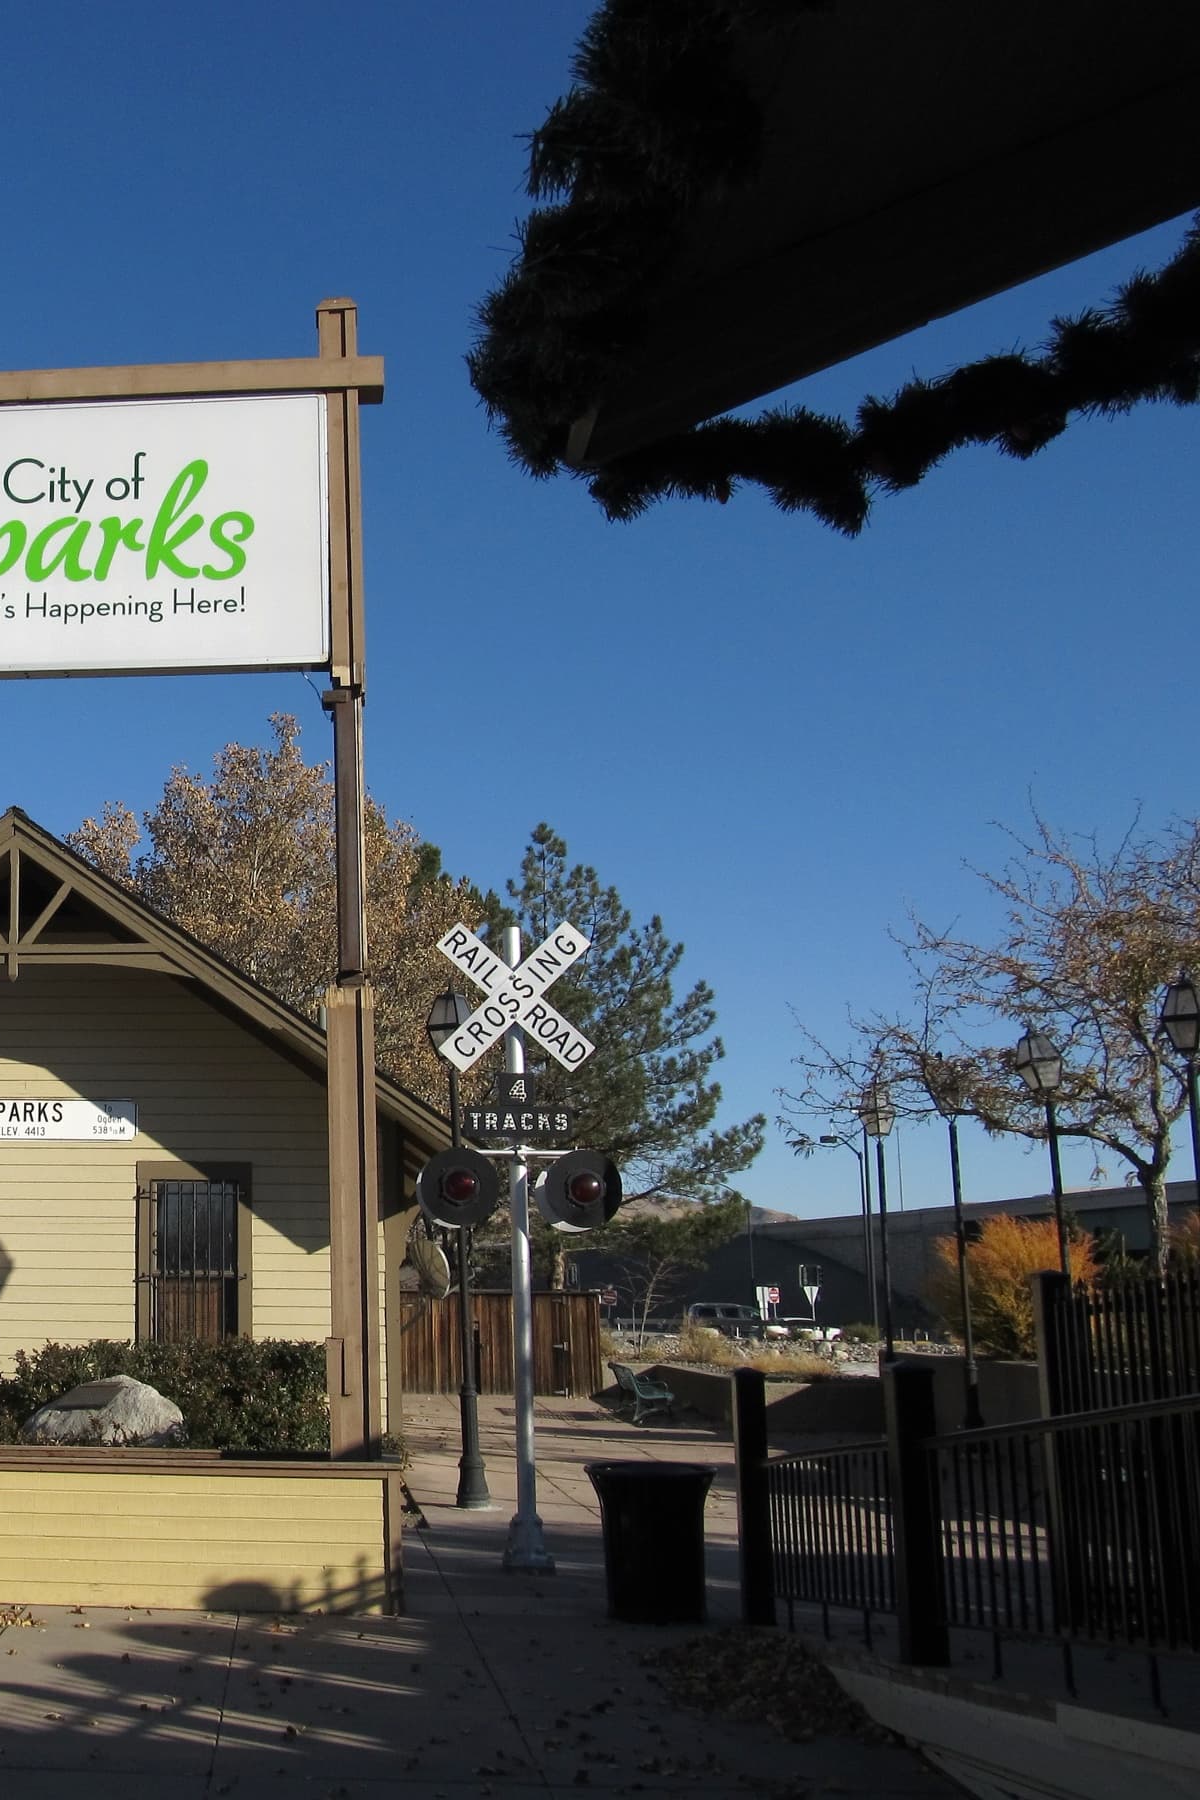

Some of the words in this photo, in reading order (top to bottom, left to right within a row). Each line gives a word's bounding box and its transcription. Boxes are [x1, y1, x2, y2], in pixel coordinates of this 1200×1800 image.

[3, 458, 95, 514] City
[105, 451, 147, 501] of
[25, 591, 164, 625] Happening
[173, 586, 246, 614] Here!
[444, 930, 498, 989] RAIL
[523, 1003, 586, 1064] ROAD
[454, 935, 577, 1058] CROSSING
[508, 1079, 527, 1103] 4
[104, 1103, 113, 1113] To
[469, 1112, 568, 1131] TRACKS
[24, 1126, 46, 1137] 4413
